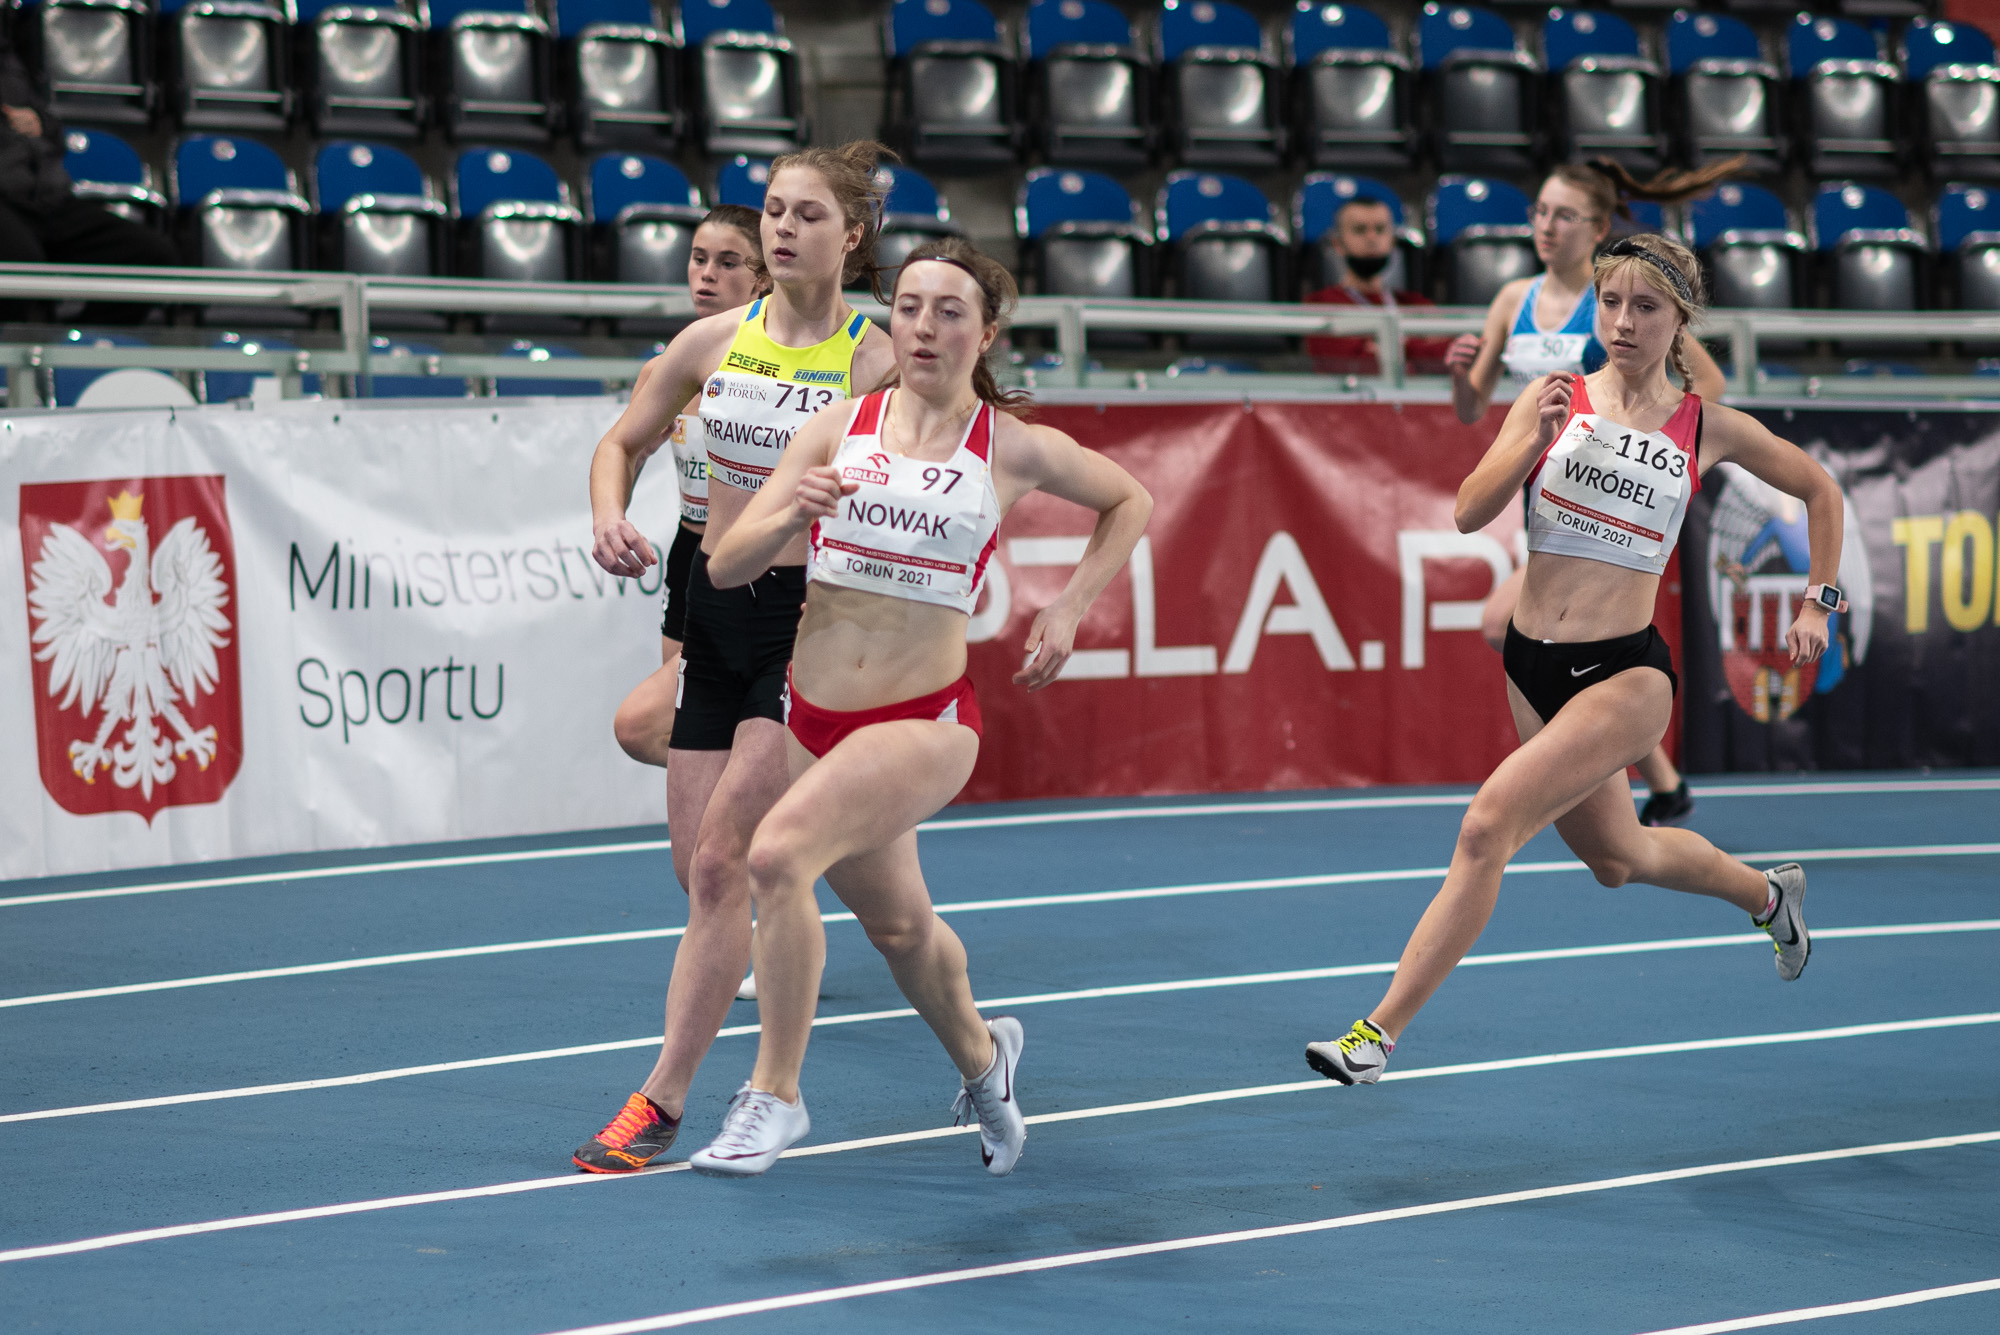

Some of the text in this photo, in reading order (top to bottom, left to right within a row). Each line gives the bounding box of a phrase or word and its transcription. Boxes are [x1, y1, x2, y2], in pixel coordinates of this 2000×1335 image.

[1540, 338, 1576, 357] 507
[729, 382, 760, 390] MIASTO
[792, 369, 847, 384] SONAROL
[727, 388, 767, 401] TORUŃ
[774, 383, 833, 413] 713
[1615, 433, 1686, 478] 1163
[844, 468, 887, 485] ORLEN
[922, 467, 963, 494] 97
[1565, 457, 1655, 510] WRÓBEL
[848, 499, 951, 540] NOWAK
[1556, 510, 1633, 548] TORUŃ 2021
[846, 557, 932, 587] TORUŃ 2021
[1892, 509, 2000, 633] TO
[967, 530, 1527, 680] ZLA.P
[297, 656, 504, 744] Sportu
